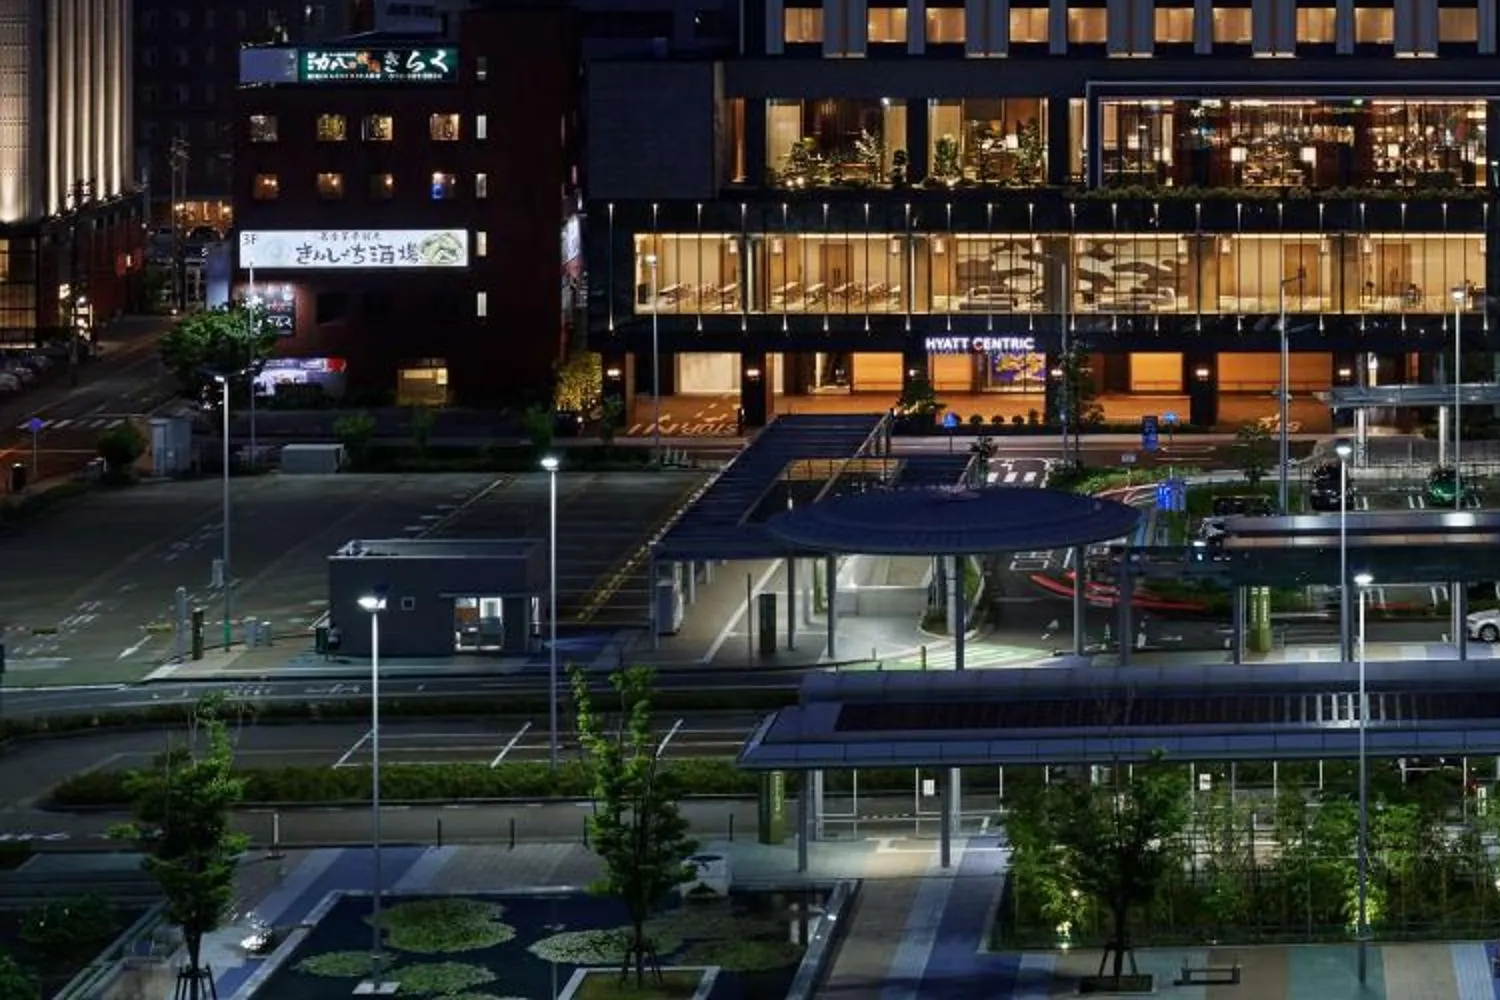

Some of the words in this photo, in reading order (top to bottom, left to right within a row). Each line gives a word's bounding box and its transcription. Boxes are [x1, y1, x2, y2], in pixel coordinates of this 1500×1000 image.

[384, 50, 449, 73] きらく
[925, 337, 969, 350] HYATT
[972, 337, 1035, 351] CENTRIC
